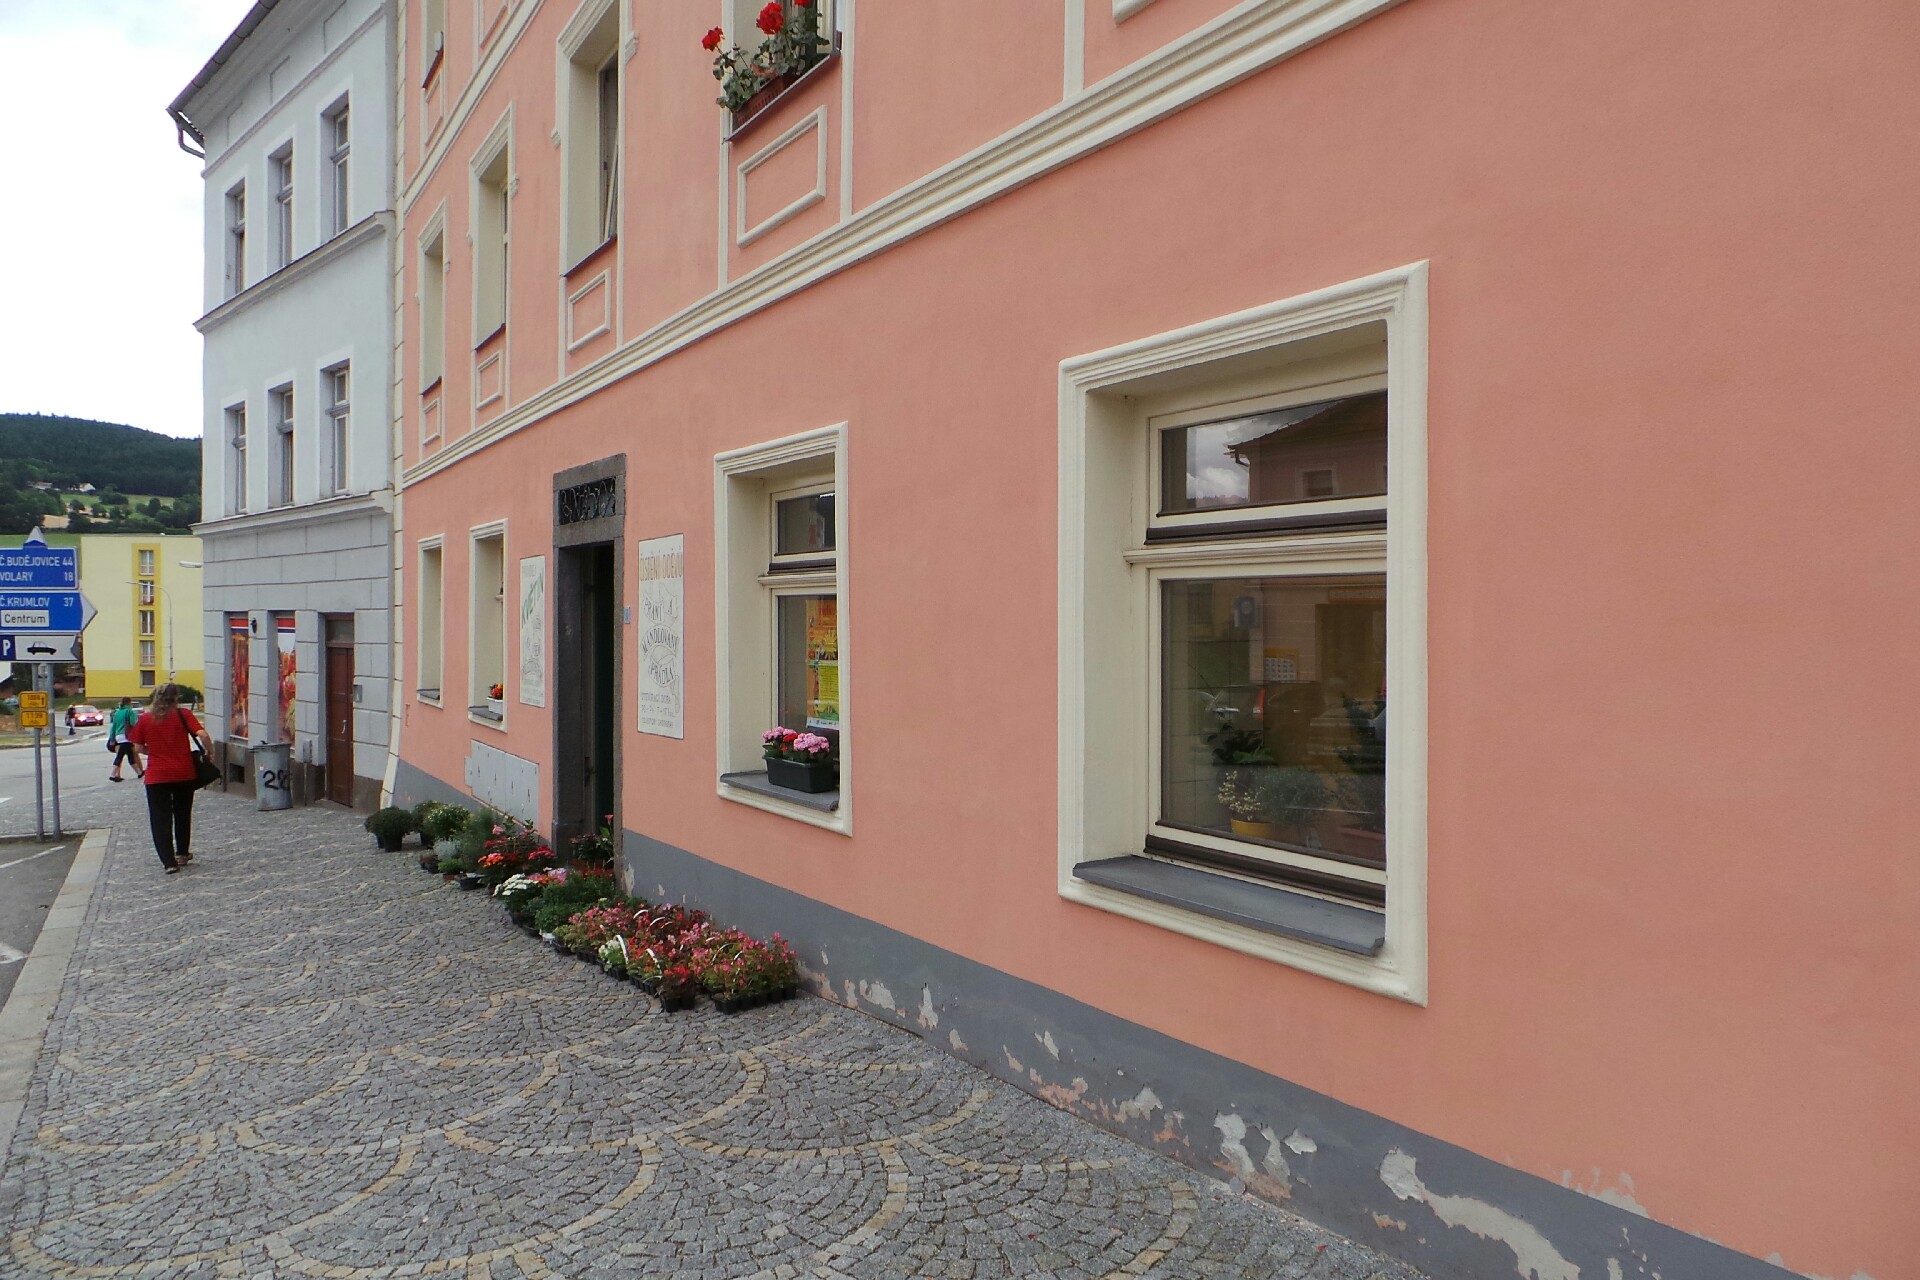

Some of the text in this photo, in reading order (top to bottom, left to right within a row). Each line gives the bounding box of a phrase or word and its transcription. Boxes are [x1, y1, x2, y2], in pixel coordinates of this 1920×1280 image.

[62, 557, 73, 566] 44
[0, 572, 73, 581] VOLARY 18
[63, 597, 74, 607] 37
[4, 614, 46, 624] Centrum
[2, 640, 11, 656] P
